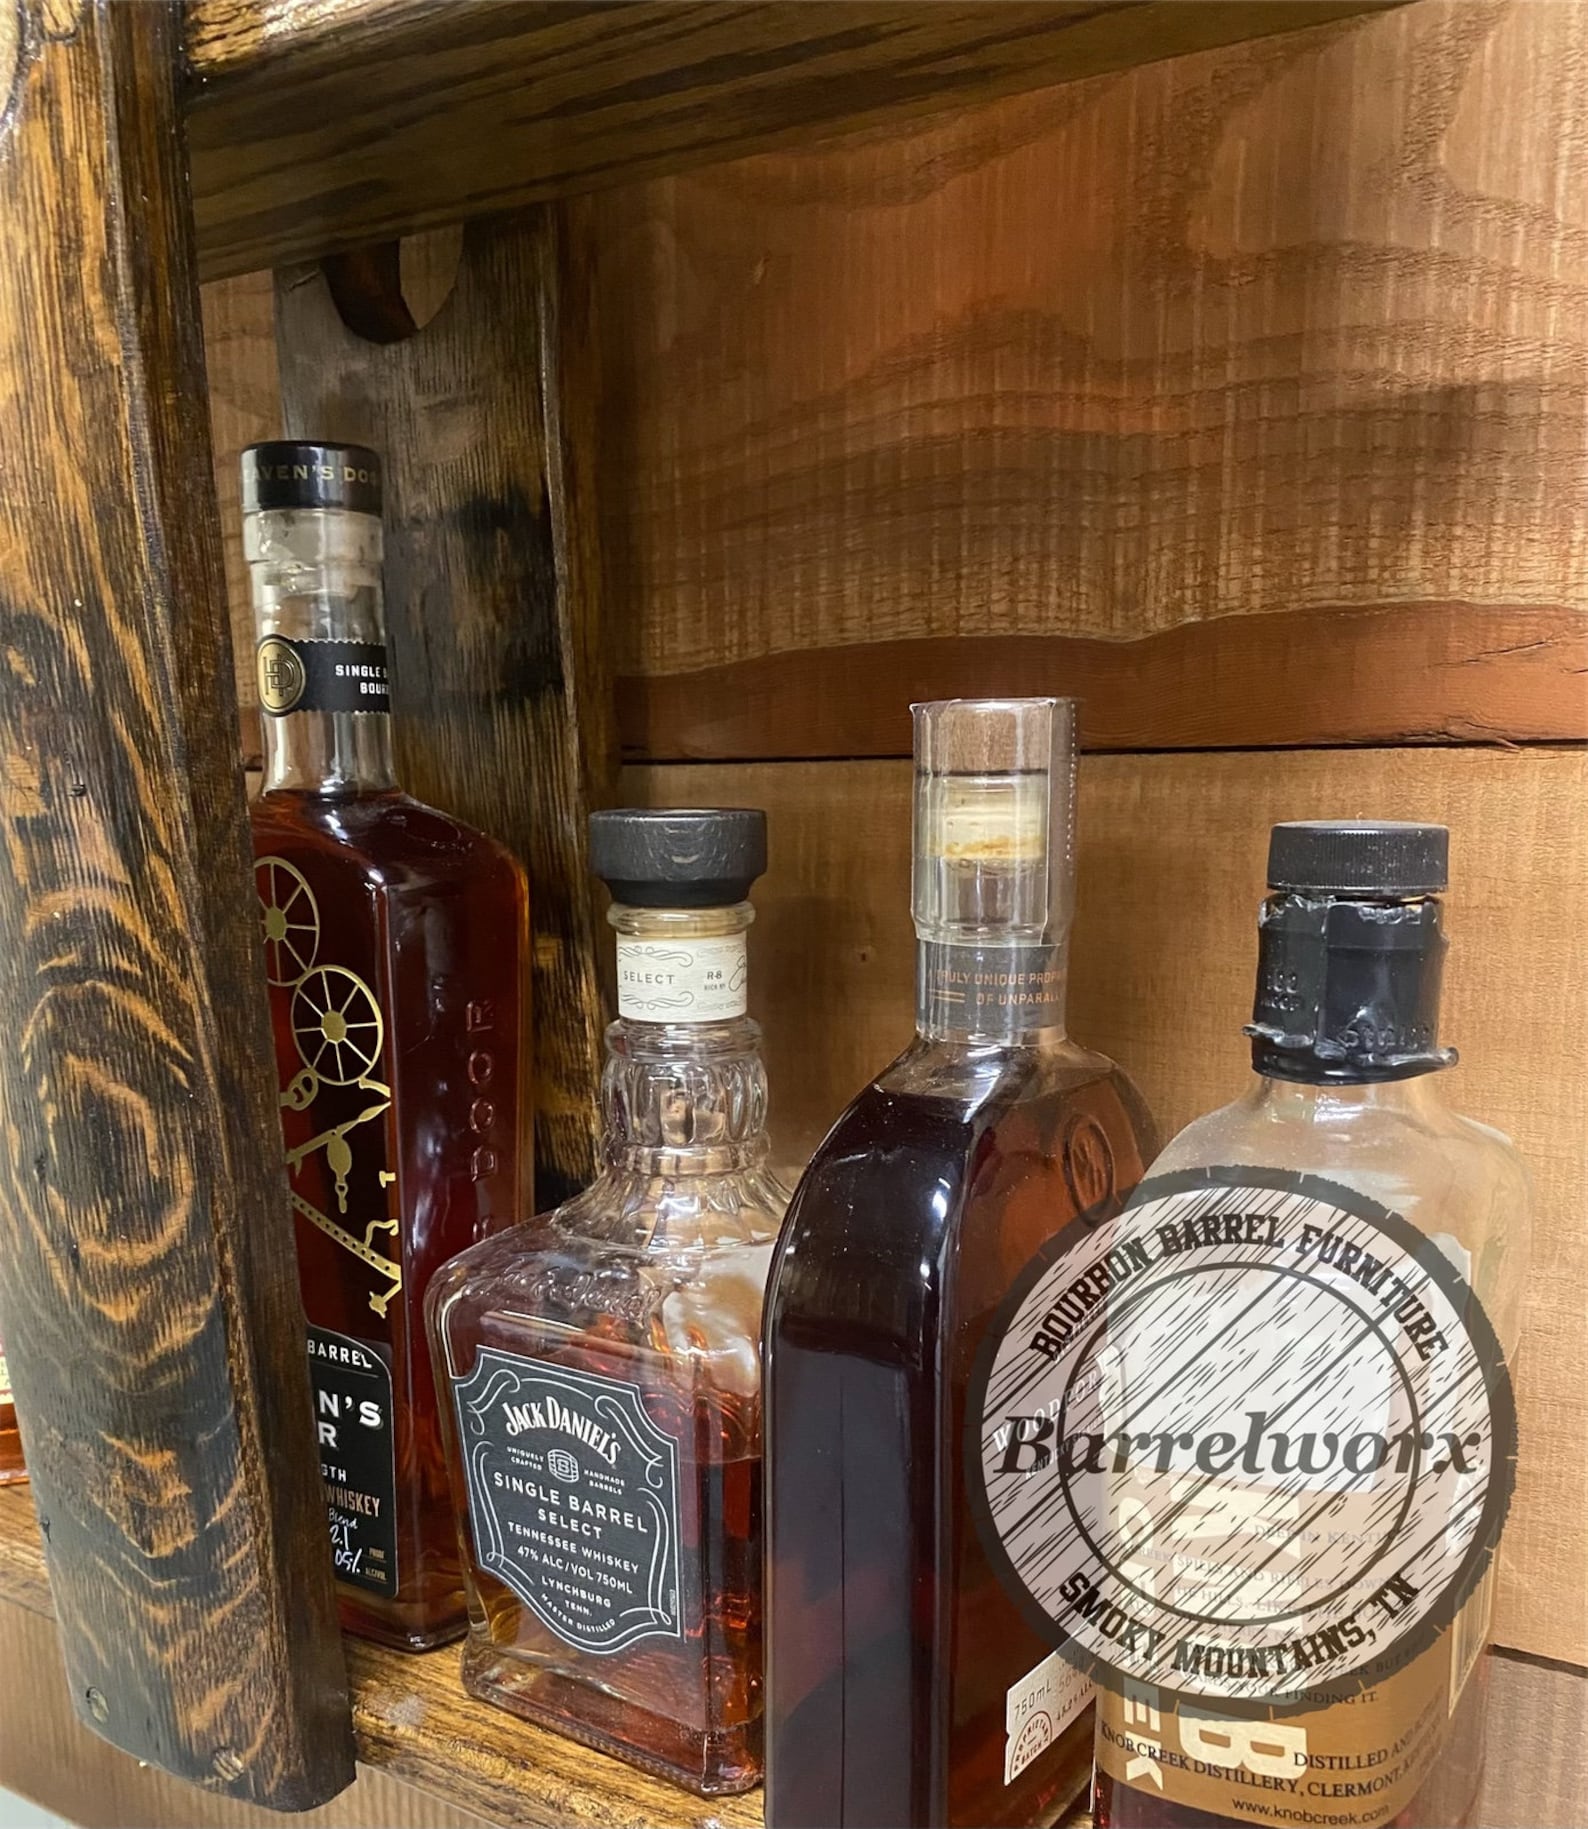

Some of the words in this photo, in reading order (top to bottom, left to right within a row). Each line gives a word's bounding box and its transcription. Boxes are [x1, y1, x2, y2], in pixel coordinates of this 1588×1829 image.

[335, 664, 382, 678] SINGLE
[624, 970, 676, 985] SELECT
[974, 972, 1025, 986] UNIQUE
[976, 992, 995, 1006] OF
[466, 1000, 498, 1183] DOOR
[307, 1338, 373, 1369] BARREL
[318, 1388, 385, 1428] N'S
[318, 1422, 341, 1449] R
[502, 1401, 548, 1436] JACK
[545, 1395, 622, 1465] DANIEL'S
[506, 1445, 545, 1463] UNIQUELY
[510, 1456, 543, 1471] CRAFTED
[320, 1462, 347, 1483] GTH
[583, 1468, 626, 1487] HANDMADE
[588, 1479, 623, 1496] BARRELS
[325, 1484, 381, 1518] WHISKEY
[493, 1471, 561, 1506] SINGLE
[568, 1494, 649, 1534] BARREL
[537, 1507, 603, 1540] SELECT
[507, 1520, 578, 1554] TENNESSEE
[581, 1546, 640, 1575] WHISKEY
[517, 1544, 539, 1562] 47%
[595, 1571, 634, 1595] 750ML
[541, 1575, 612, 1609] LYNCHBURG
[541, 1592, 574, 1626] MASTER
[576, 1617, 616, 1633] DISTILLED
[1014, 1678, 1052, 1721] 750mL
[1286, 1690, 1356, 1706] FINDING
[1021, 1741, 1043, 1765] BATCH
[1101, 1721, 1135, 1752] KNOB
[1136, 1742, 1191, 1773] CREEK
[1193, 1760, 1305, 1798] DISTILLERY,
[1294, 1747, 1388, 1771] DISTILLED
[1231, 1796, 1391, 1827] www.knobcreek.com
